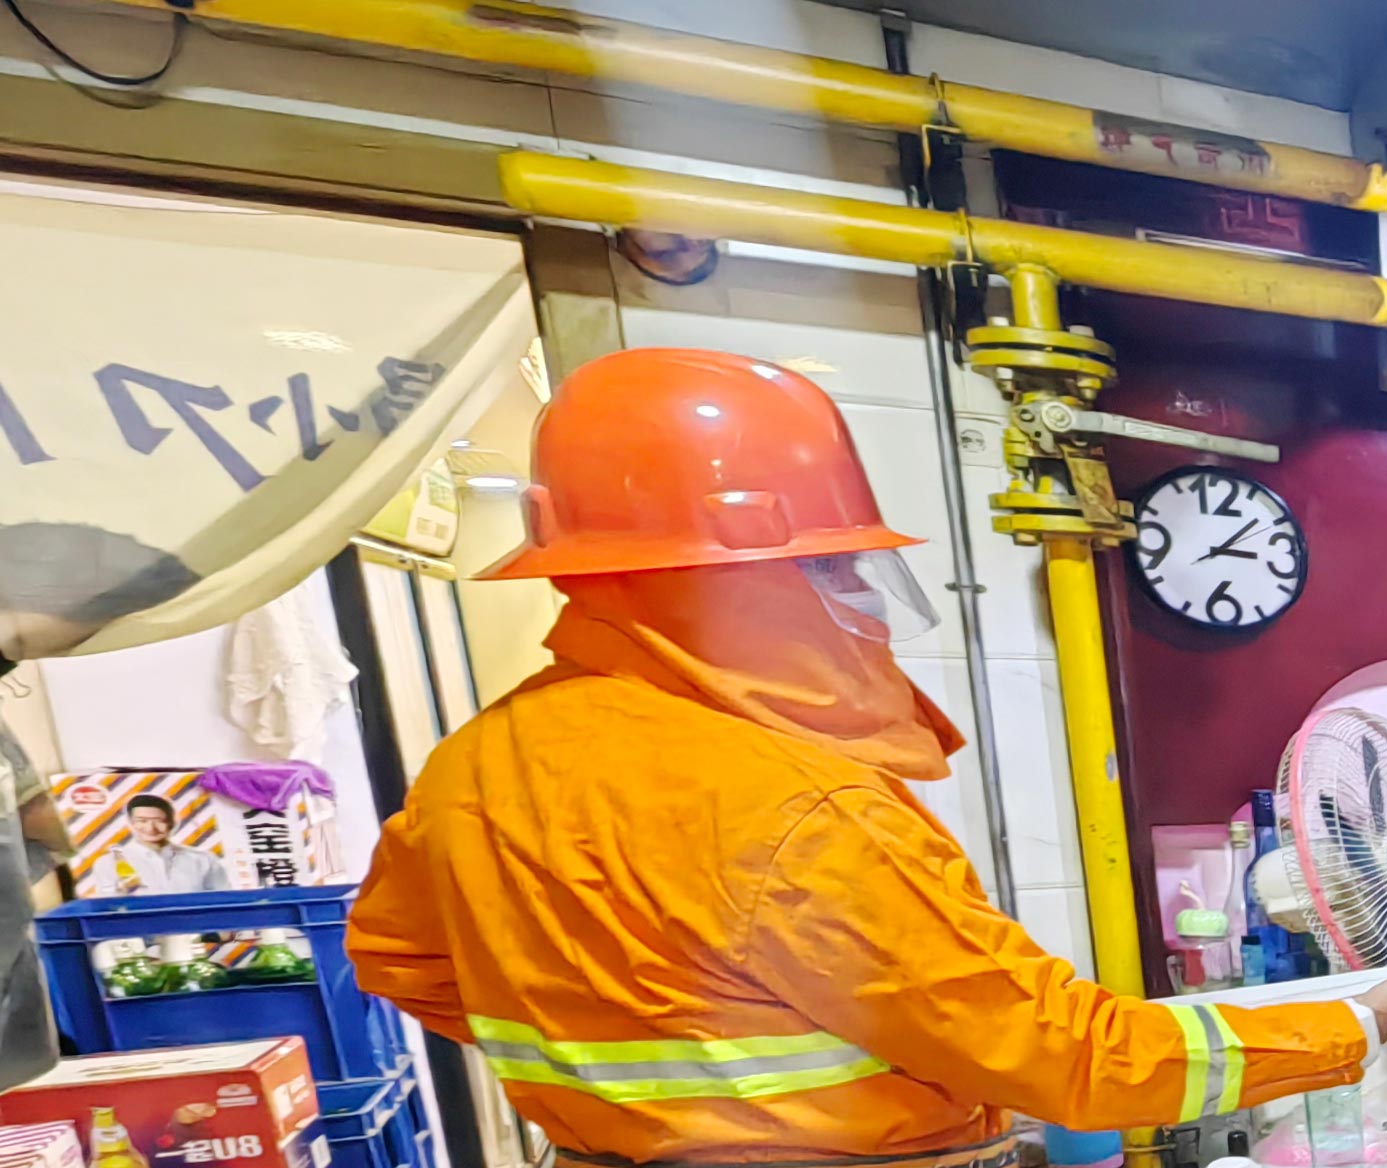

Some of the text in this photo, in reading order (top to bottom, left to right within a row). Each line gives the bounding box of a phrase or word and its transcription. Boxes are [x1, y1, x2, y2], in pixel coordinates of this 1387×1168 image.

[1188, 474, 1242, 517] 12
[1138, 521, 1171, 570] 9
[1267, 532, 1299, 580] 3
[1206, 581, 1242, 625] 6
